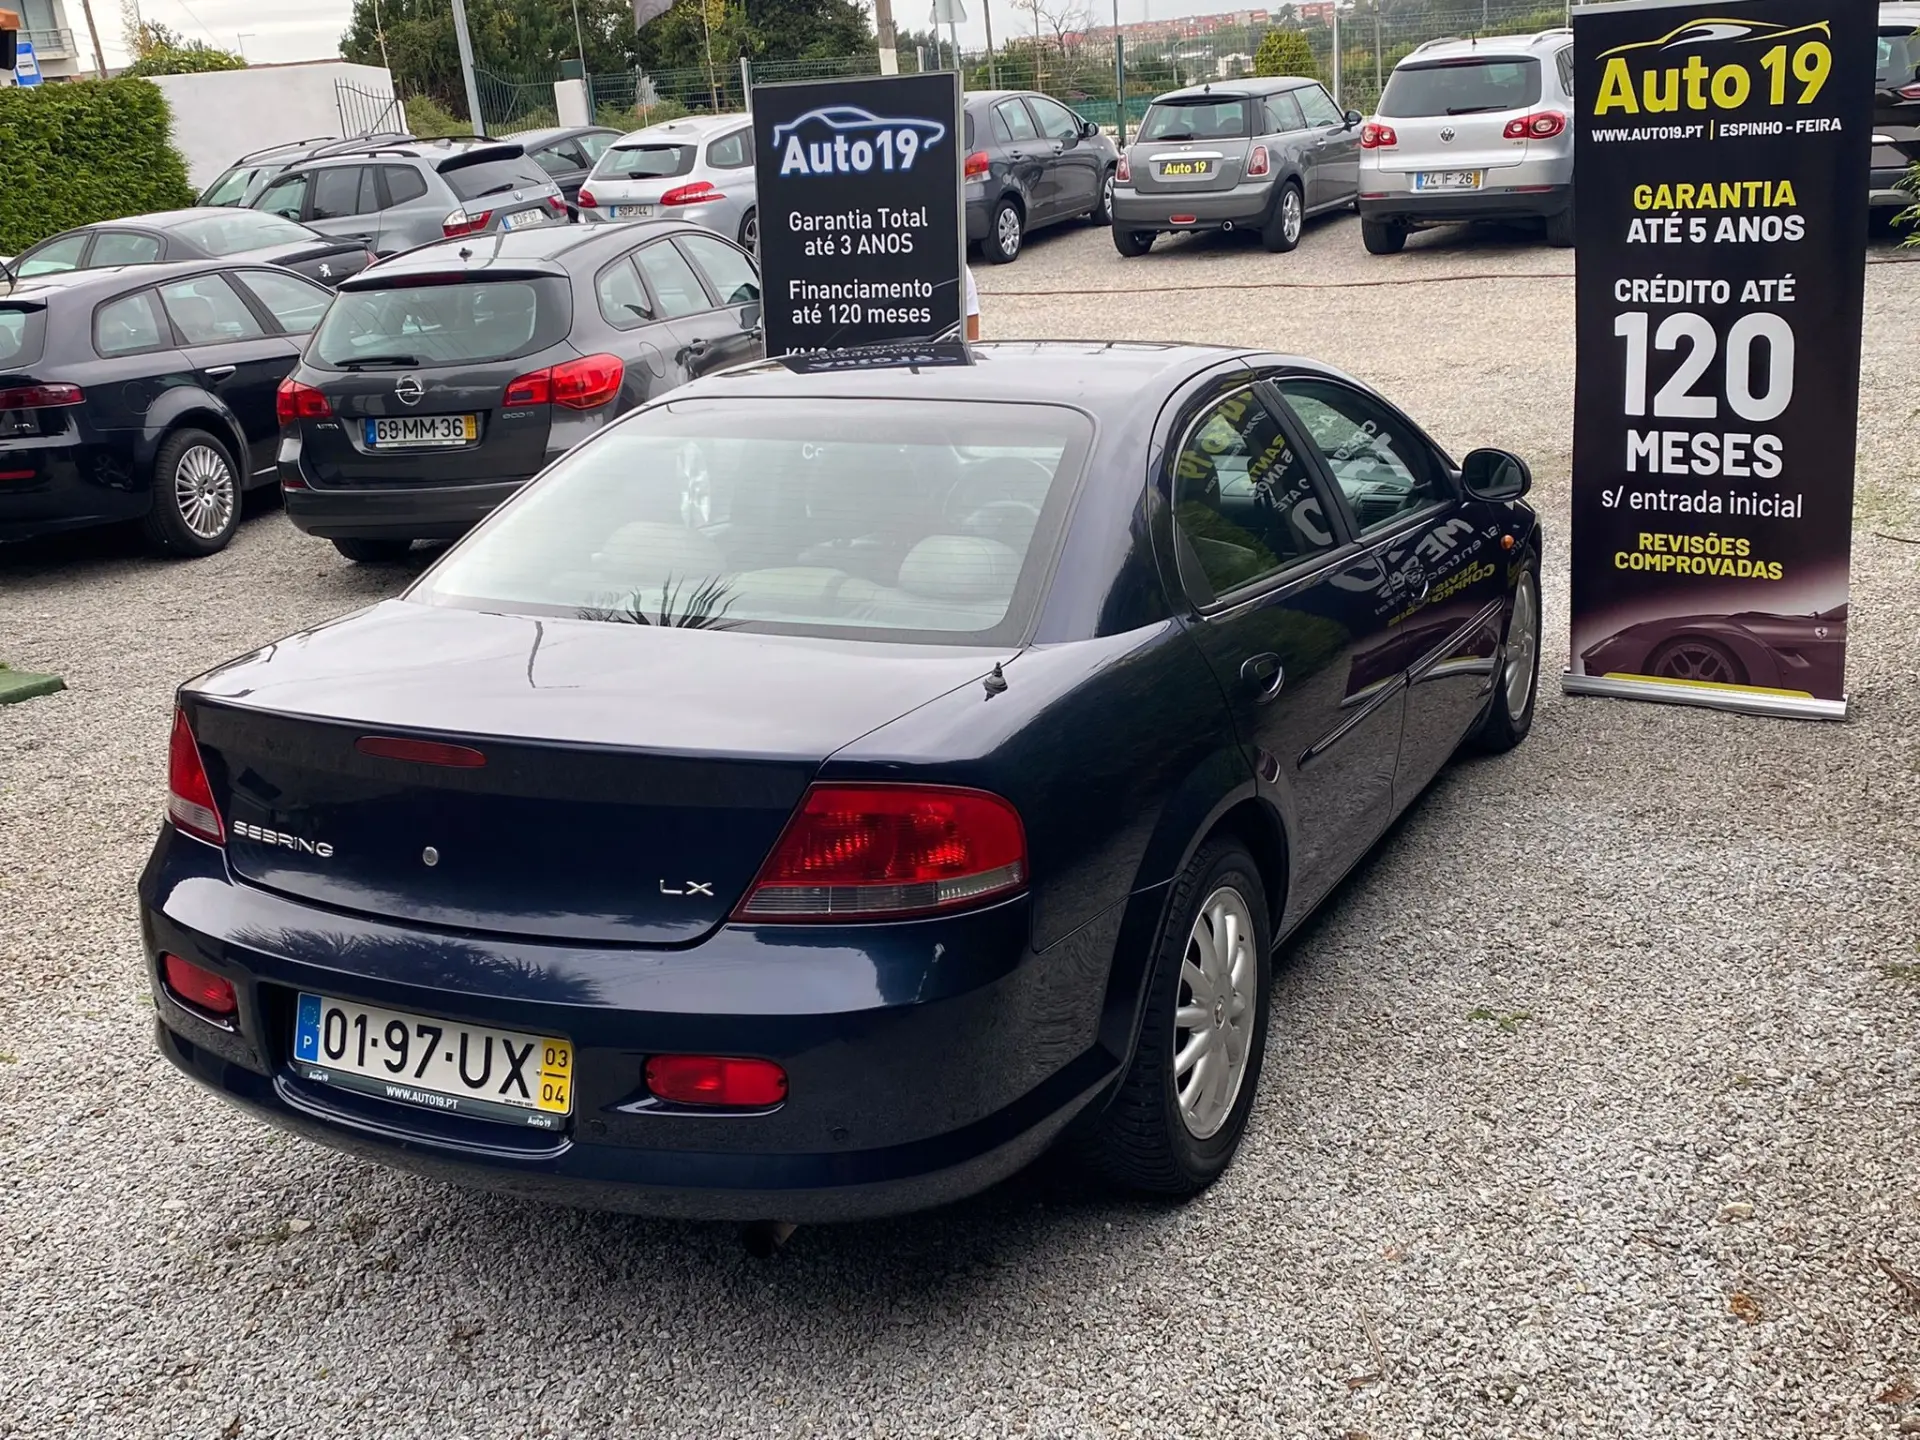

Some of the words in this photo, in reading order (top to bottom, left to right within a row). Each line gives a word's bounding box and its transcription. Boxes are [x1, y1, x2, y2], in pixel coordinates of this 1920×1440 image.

[1594, 56, 1751, 115] Auto
[1760, 41, 1832, 105] 19
[1592, 123, 1704, 143] WWW.AUTO19.PT
[1719, 120, 1782, 137] ESPINHO
[1796, 117, 1842, 134] FEIRA
[1164, 163, 1192, 174] Auto
[1194, 161, 1207, 173] 19
[1633, 179, 1797, 211] GARANTIA
[789, 209, 872, 232] Garantia
[877, 206, 928, 228] Total
[1626, 211, 1683, 244] ATÉ
[1689, 217, 1707, 243] 5
[1713, 214, 1806, 244] ANOS
[804, 232, 835, 256] até
[840, 235, 852, 255] 3
[857, 233, 914, 255] ANOS
[789, 279, 933, 301] Financiamento
[1614, 273, 1730, 303] CRÉDITO
[1739, 273, 1797, 303] ATÉ
[792, 303, 822, 325] até
[828, 304, 861, 324] 120
[867, 307, 931, 324] meses
[1613, 310, 1795, 422] 120
[1625, 428, 1783, 479] MESES
[1601, 485, 1624, 510] s/
[1631, 489, 1723, 515] entrada
[1729, 490, 1803, 519] inicial
[1638, 530, 1751, 557] REVISÕES
[1614, 551, 1784, 581] COMPROVADAS
[233, 820, 334, 858] SEBRING
[659, 879, 715, 897] LX
[302, 1034, 313, 1049] P
[545, 1047, 569, 1068] 03
[386, 1085, 459, 1110] WWW.AUTO19.PT
[542, 1085, 565, 1104] 04
